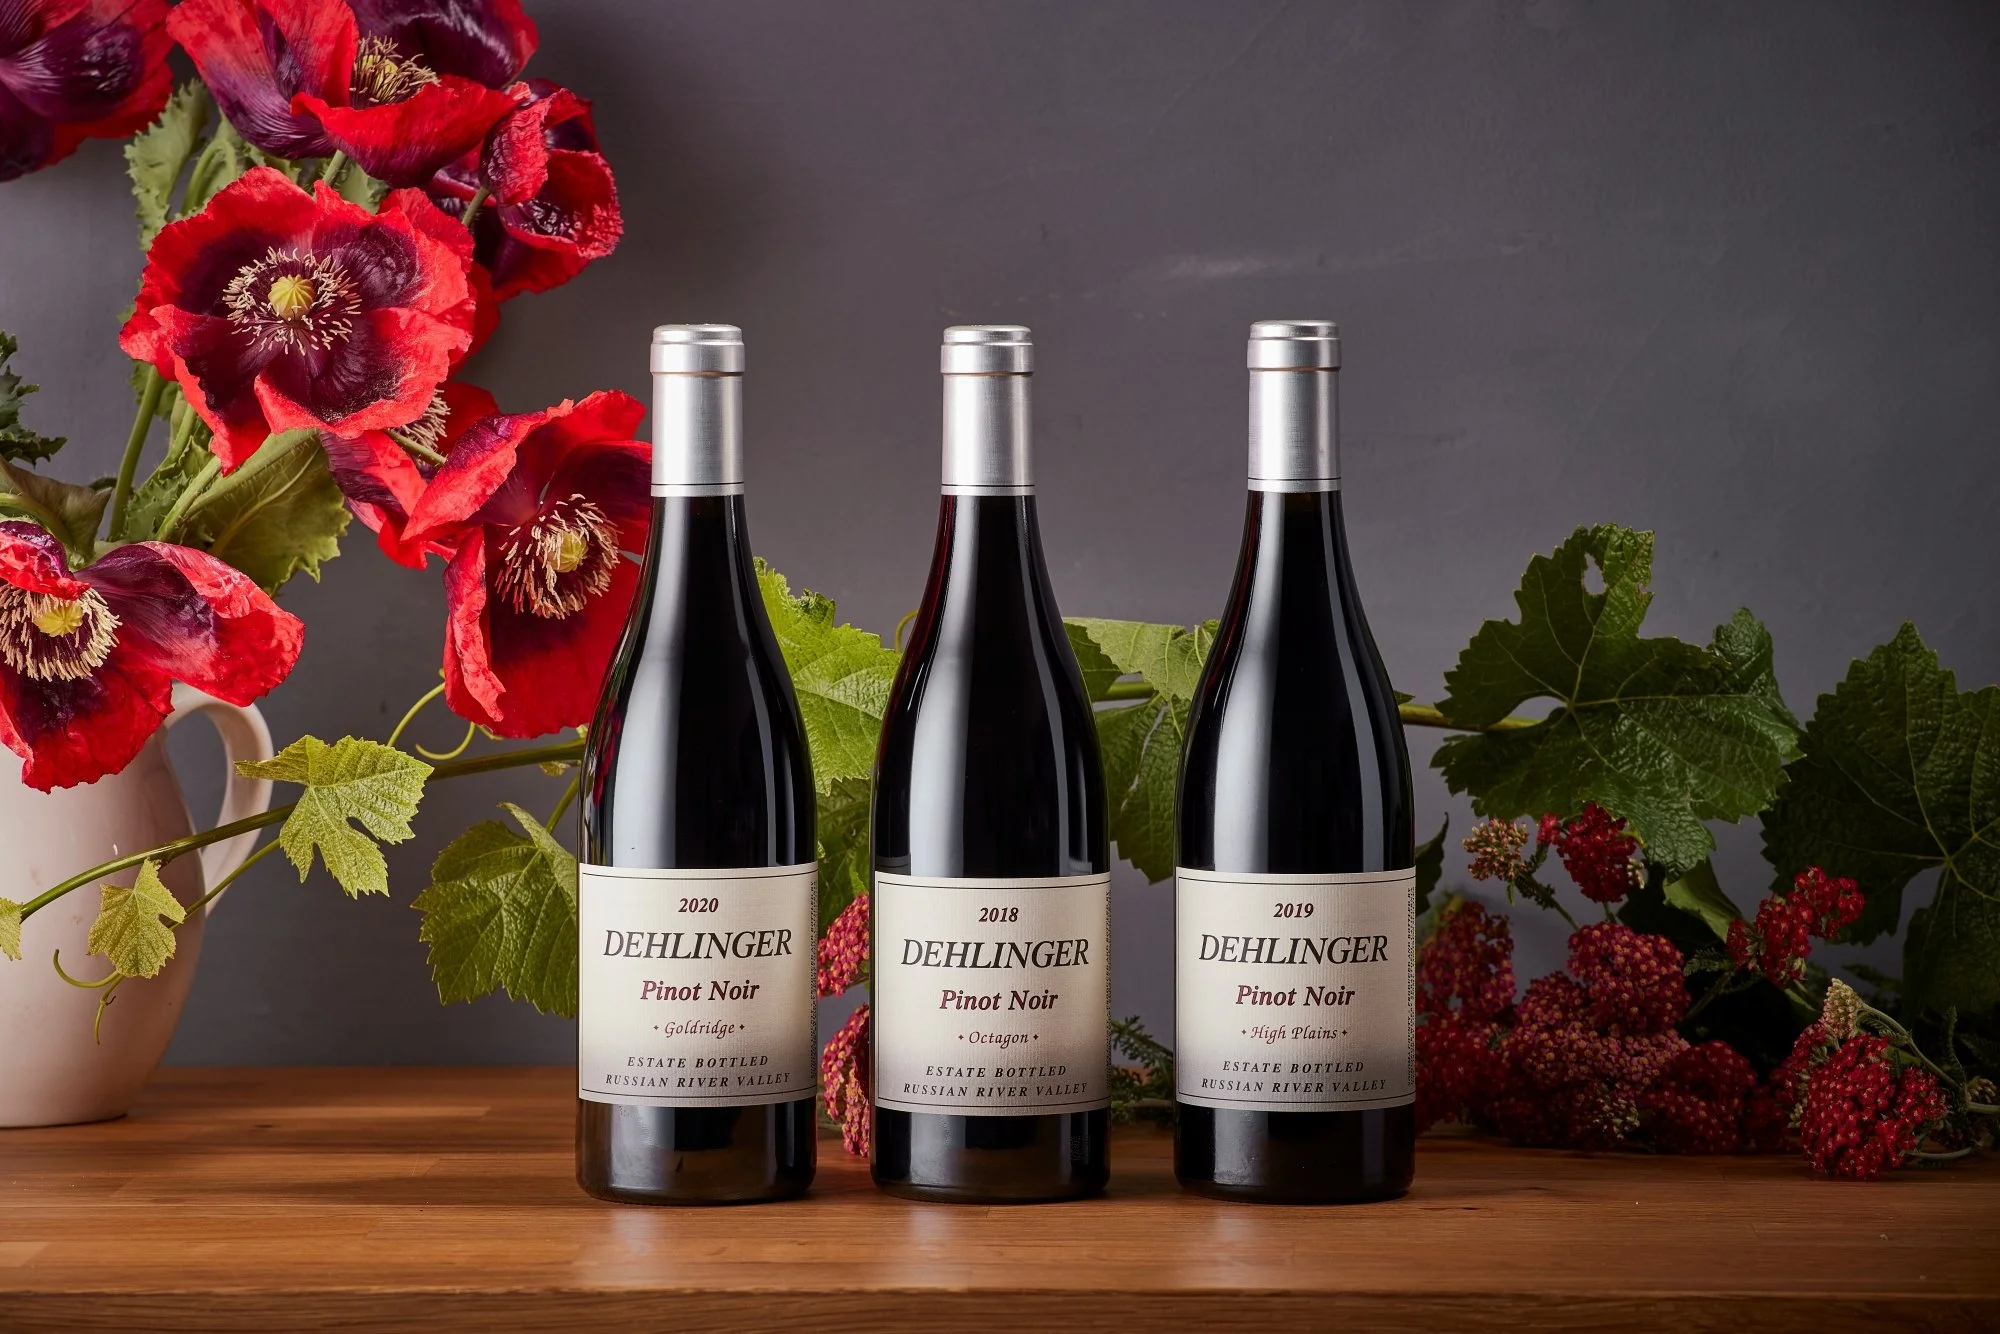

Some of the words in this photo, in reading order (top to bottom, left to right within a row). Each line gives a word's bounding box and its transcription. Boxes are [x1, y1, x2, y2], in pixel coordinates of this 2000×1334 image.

[678, 898, 719, 913] 2020
[1273, 903, 1314, 918] 2019
[979, 907, 1019, 923] 2018
[603, 929, 792, 959] DEHLINGER
[1199, 934, 1388, 965] DEHLINGER
[901, 938, 1089, 969] DEHLINGER
[640, 980, 702, 1001] Pinot
[708, 980, 760, 1001] Noir
[1236, 985, 1297, 1006] Pinot
[1303, 985, 1355, 1006] Noir
[939, 990, 1001, 1011] Pinot
[1008, 990, 1058, 1011] Noir
[665, 1020, 735, 1039] Goldridge
[1250, 1025, 1286, 1045] High
[1291, 1027, 1338, 1040] Plains
[969, 1031, 1029, 1049] Octagon
[627, 1057, 687, 1068] ESTATE
[695, 1056, 768, 1068] BOTTLED
[1223, 1061, 1282, 1073] ESTATE
[1290, 1062, 1364, 1073] BOTTLED
[606, 1074, 669, 1087] RUSSIAN
[677, 1077, 729, 1088] RIVER
[737, 1073, 791, 1087] VALLEY
[926, 1066, 986, 1078] ESTATE
[994, 1066, 1067, 1078] BOTTLED
[904, 1083, 968, 1097] RUSSIAN
[976, 1086, 1028, 1097] RIVER
[1036, 1083, 1088, 1096] VALLEY
[1202, 1078, 1264, 1092] RUSSIAN
[1272, 1082, 1324, 1093] RIVER
[1332, 1079, 1387, 1092] VALLEY
